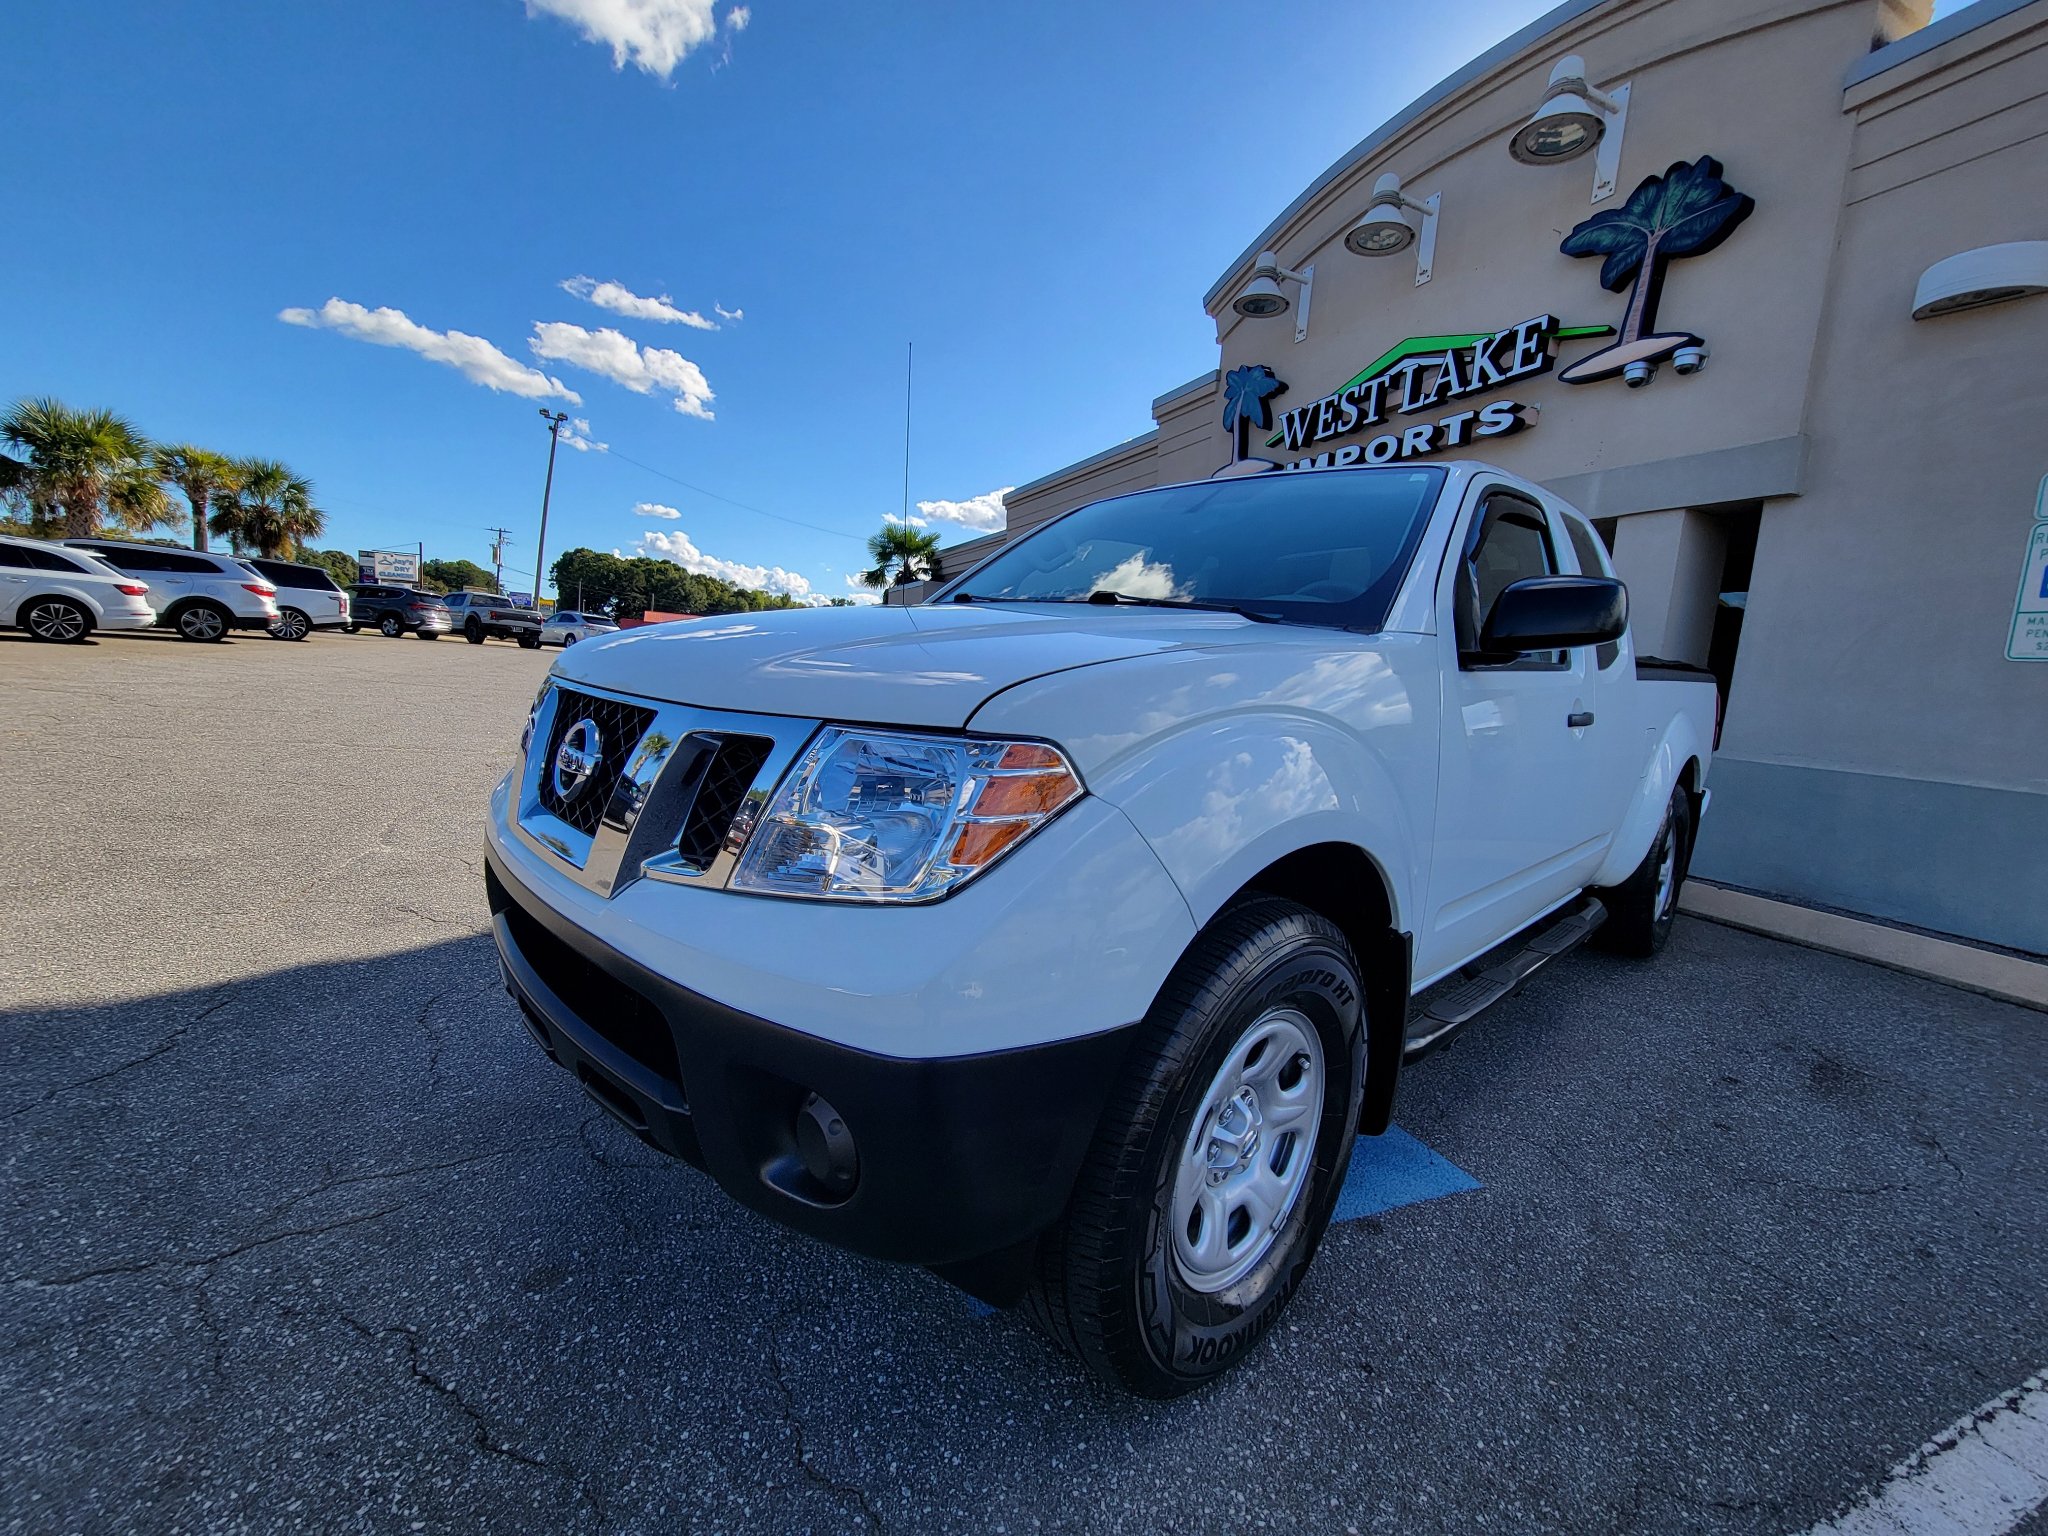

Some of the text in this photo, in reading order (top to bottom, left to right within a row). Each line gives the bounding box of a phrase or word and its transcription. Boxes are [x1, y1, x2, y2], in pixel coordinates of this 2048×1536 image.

[1278, 314, 1551, 451] WEST LAKE
[392, 559, 414, 567] Jay's
[379, 571, 415, 580] CLEANERS
